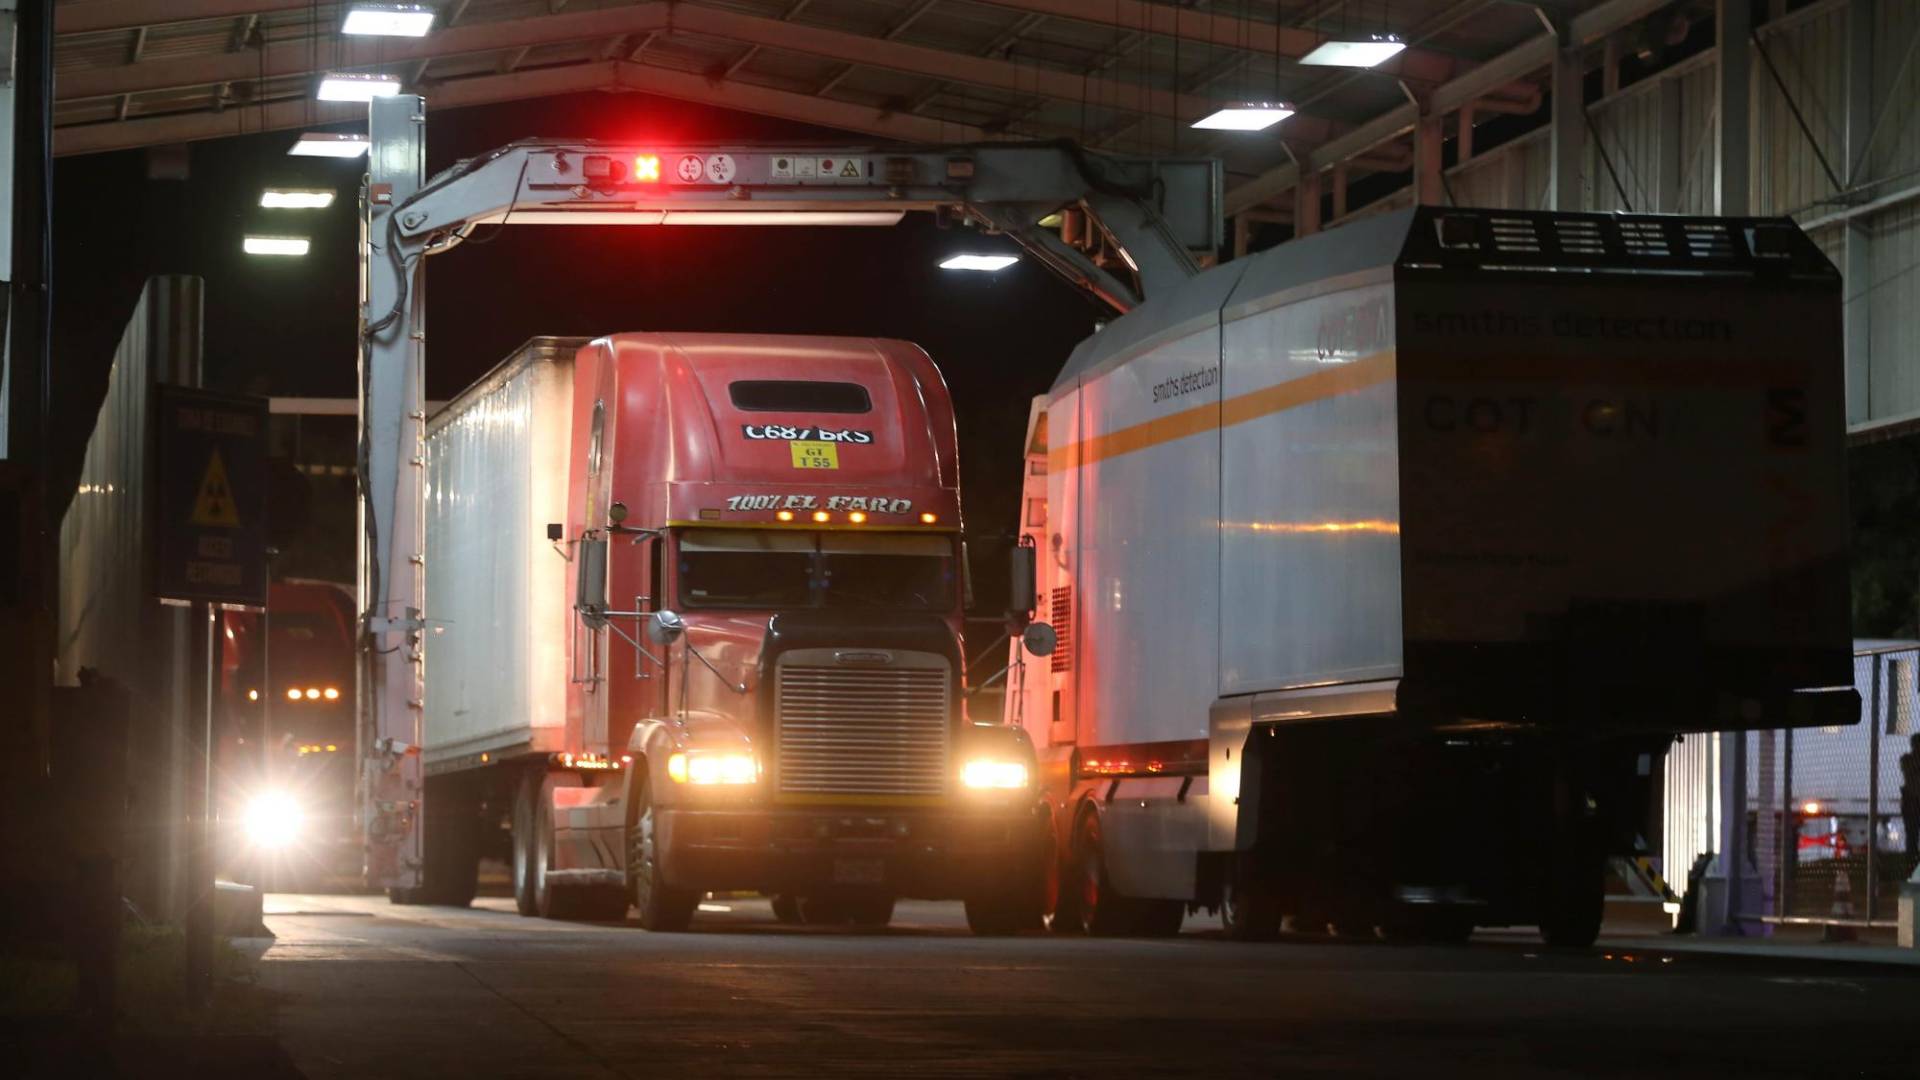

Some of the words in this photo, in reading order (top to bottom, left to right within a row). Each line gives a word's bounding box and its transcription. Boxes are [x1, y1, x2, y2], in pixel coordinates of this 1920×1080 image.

[1414, 308, 1541, 338] smiths
[1551, 311, 1734, 342] detection
[1153, 376, 1179, 403] smiths
[1180, 367, 1218, 395] detection
[812, 457, 831, 468] 55
[727, 494, 781, 512] 100%
[783, 494, 819, 510] EL
[826, 495, 912, 515] FARO
